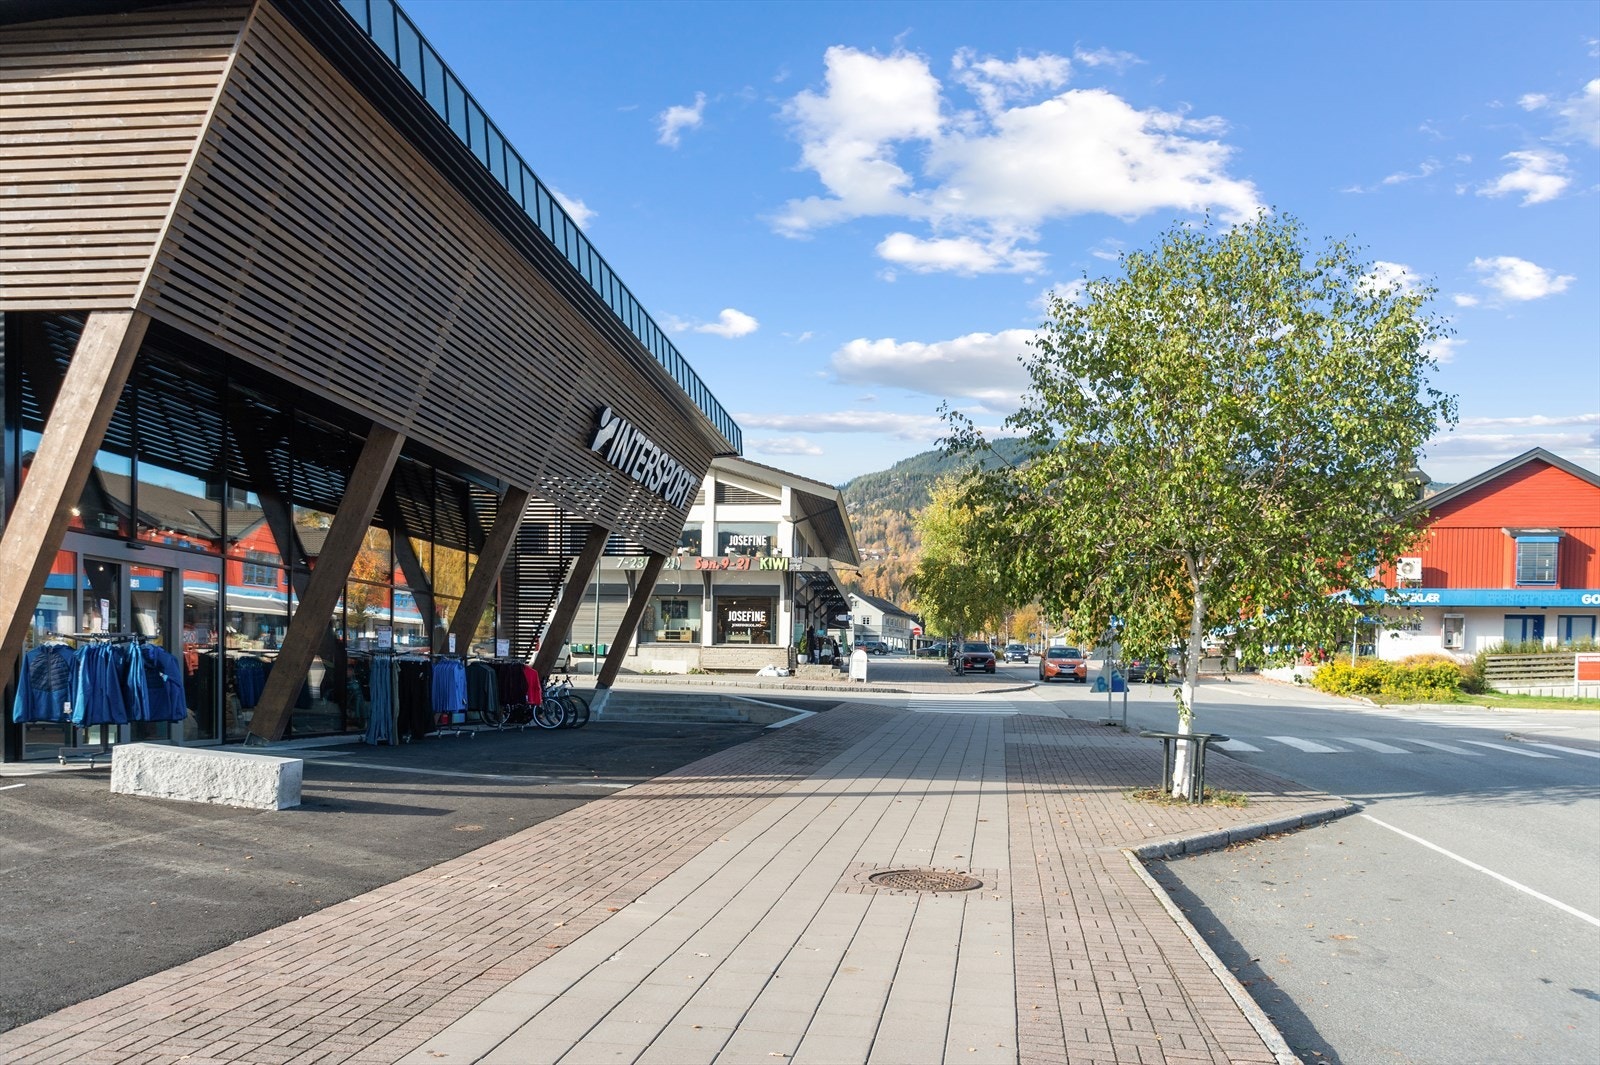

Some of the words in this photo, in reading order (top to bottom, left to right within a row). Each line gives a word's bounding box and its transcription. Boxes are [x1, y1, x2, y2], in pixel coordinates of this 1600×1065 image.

[607, 419, 698, 510] INTERSPORT
[729, 535, 767, 546] JOSEFINE
[759, 557, 789, 570] KIWI
[727, 610, 766, 622] JOSEFINE
